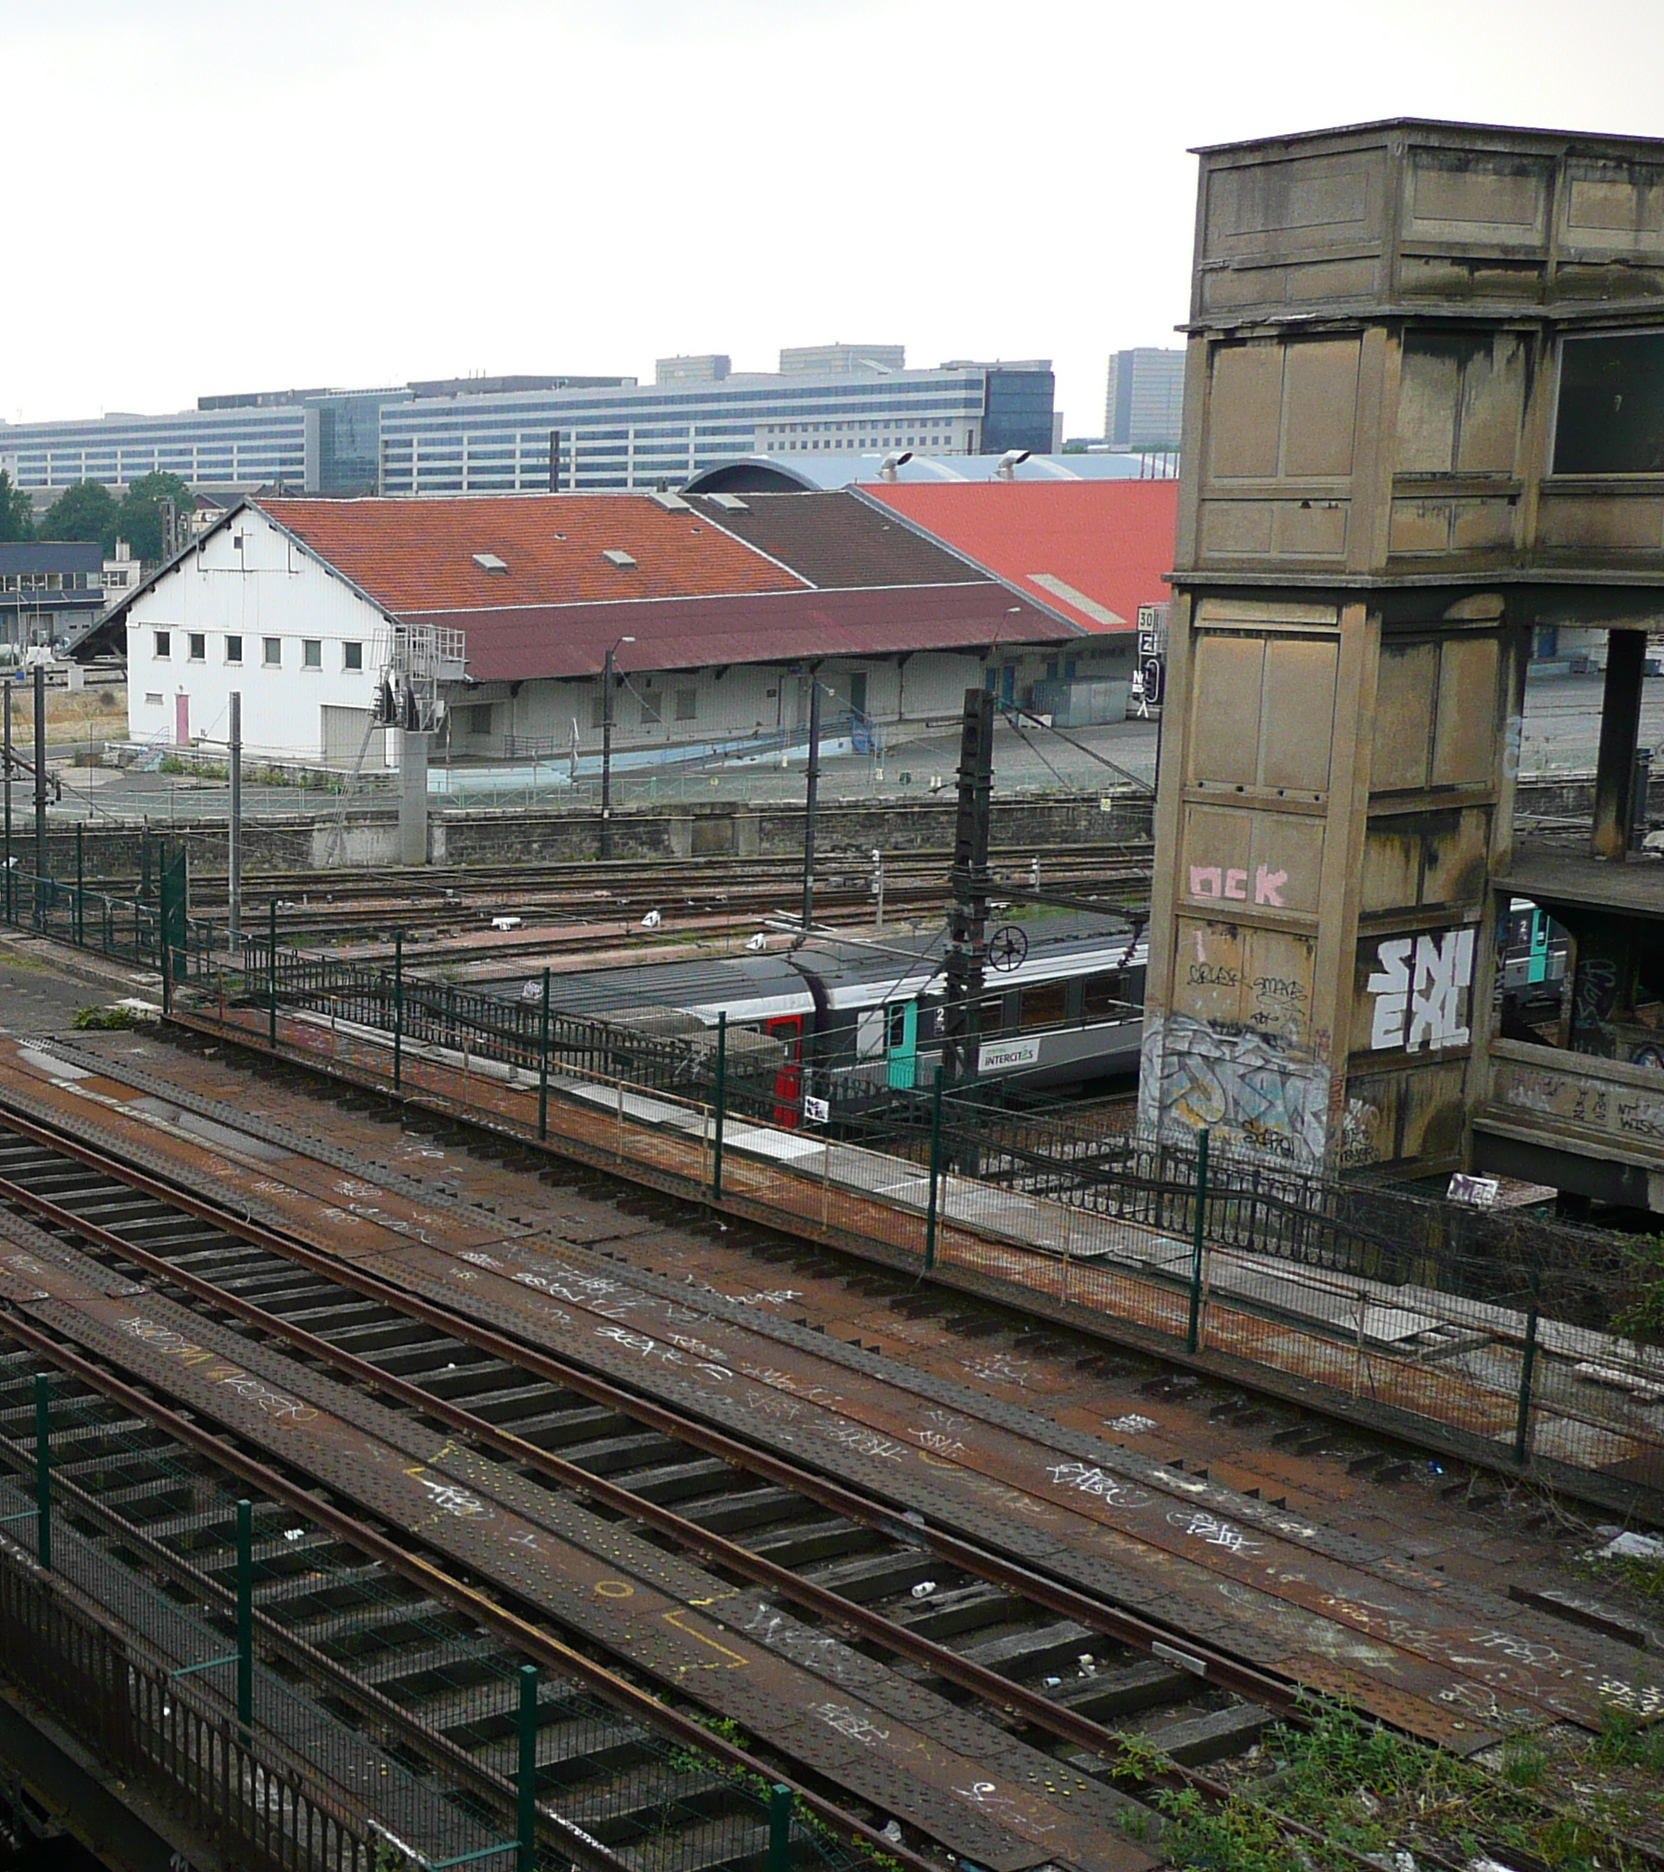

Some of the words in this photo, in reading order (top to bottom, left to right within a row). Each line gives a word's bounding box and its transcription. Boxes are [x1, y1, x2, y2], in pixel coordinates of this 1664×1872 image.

[1140, 612, 1153, 626] 30
[1189, 863, 1288, 908] OCK
[1519, 920, 1528, 932] 2
[1367, 929, 1475, 993] SNI
[936, 1007, 945, 1021] 2
